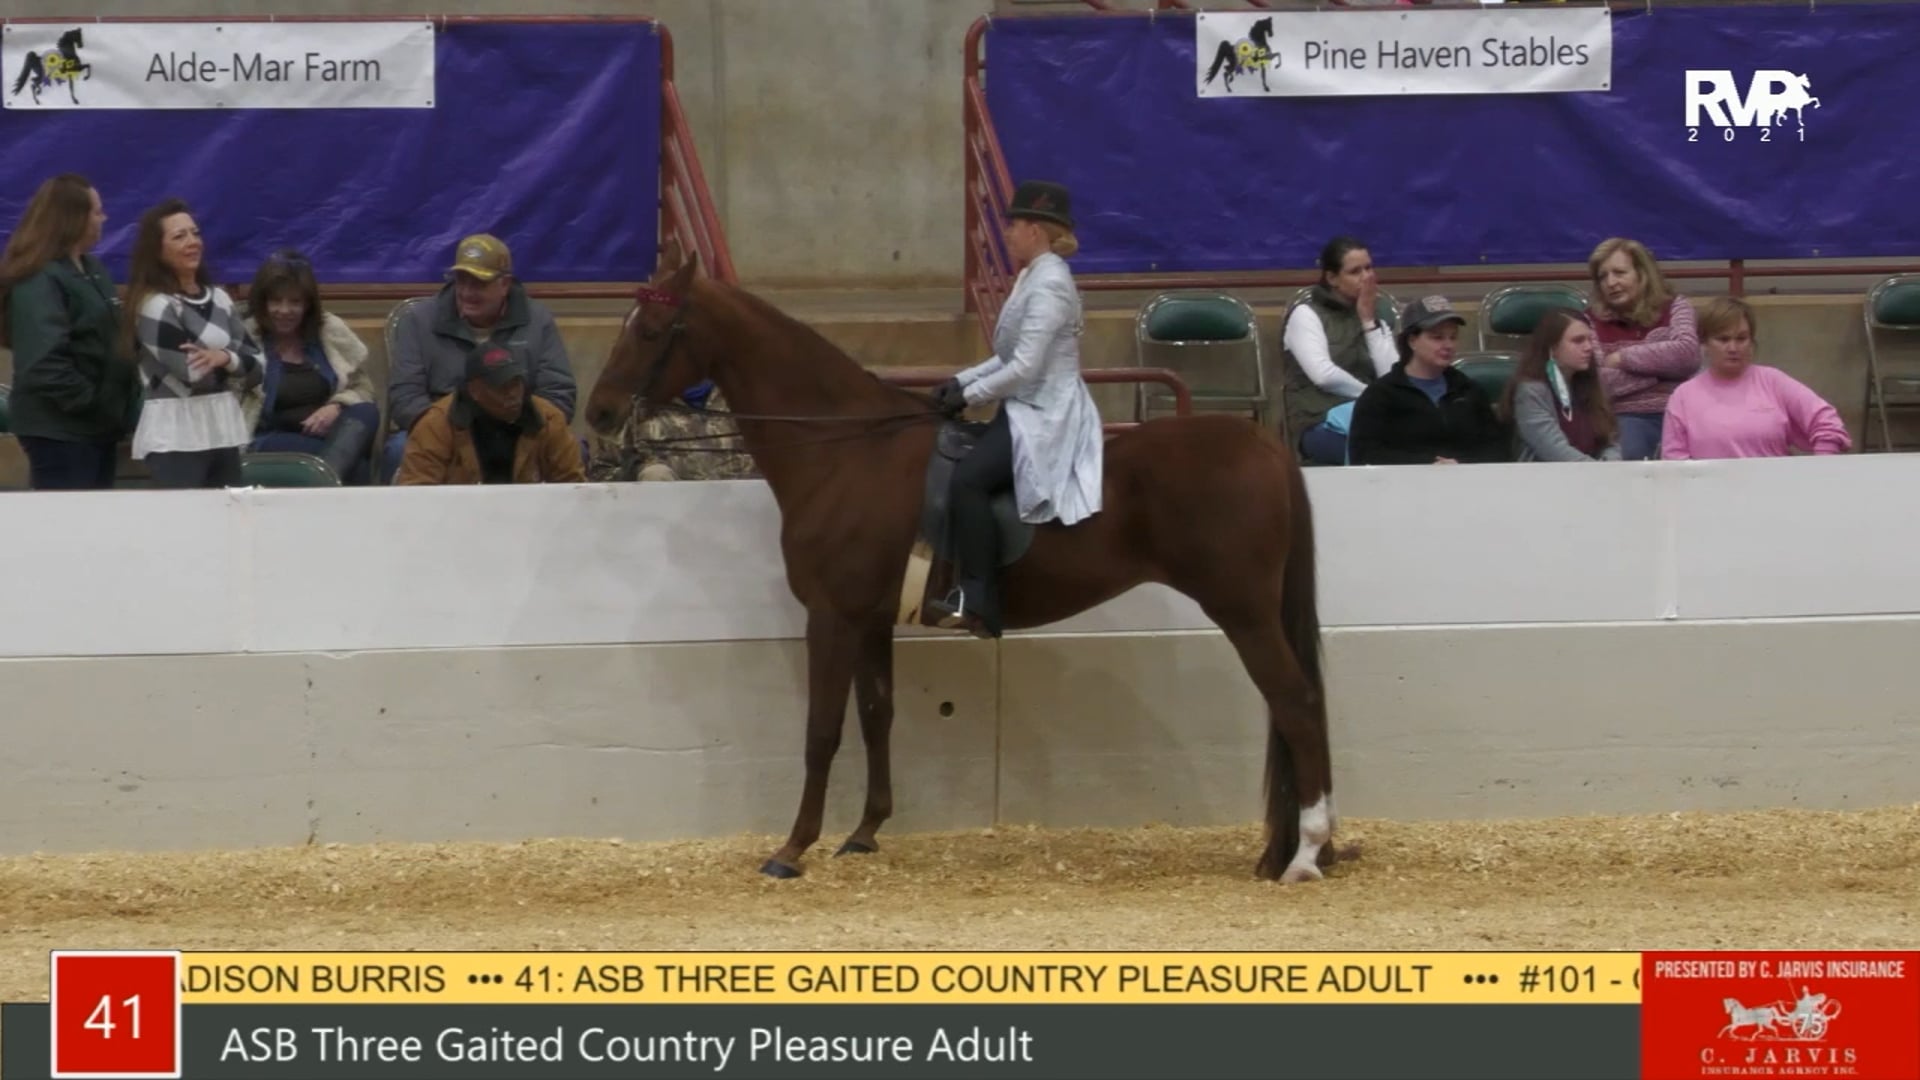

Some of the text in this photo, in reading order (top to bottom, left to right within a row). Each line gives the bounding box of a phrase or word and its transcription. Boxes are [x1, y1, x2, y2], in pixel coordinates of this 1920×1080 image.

[145, 52, 380, 83] Alde-Mar Farm
[1304, 36, 1589, 70] Pine Haven Stables
